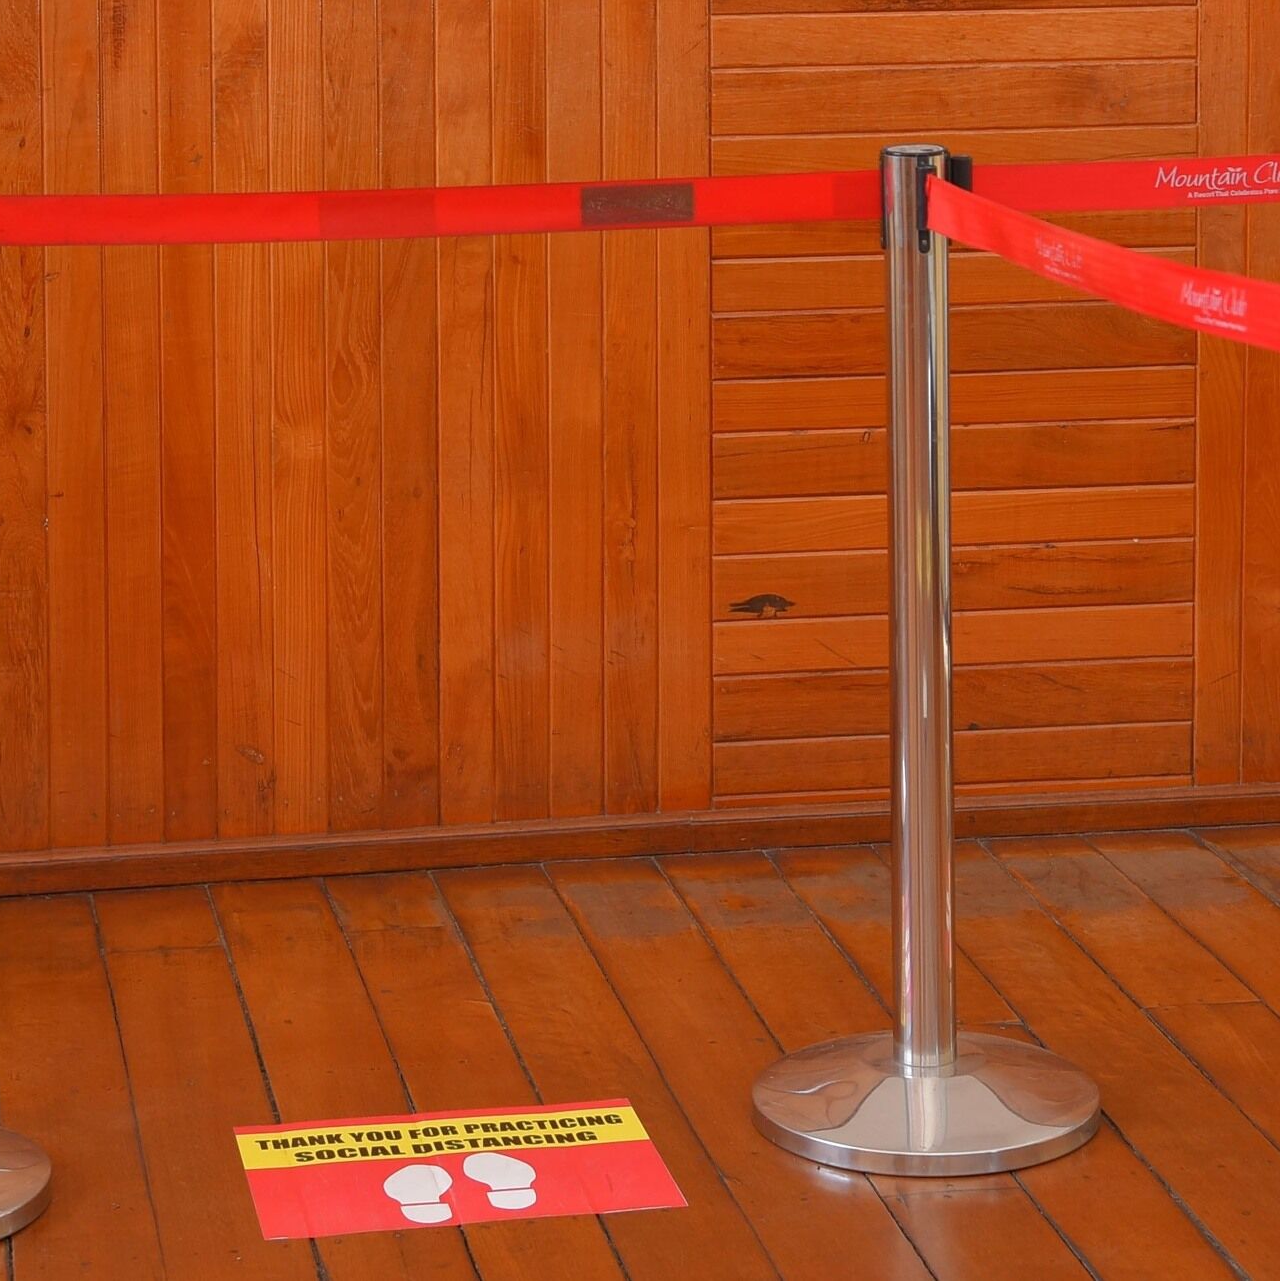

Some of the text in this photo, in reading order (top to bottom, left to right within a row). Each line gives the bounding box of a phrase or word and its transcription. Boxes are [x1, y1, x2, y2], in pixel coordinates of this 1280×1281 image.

[1155, 165, 1251, 190] Mountain
[255, 1113, 624, 1151] THANK YOU FOR PRACTICING
[294, 1130, 598, 1164] SOCIAL DISTANCING
